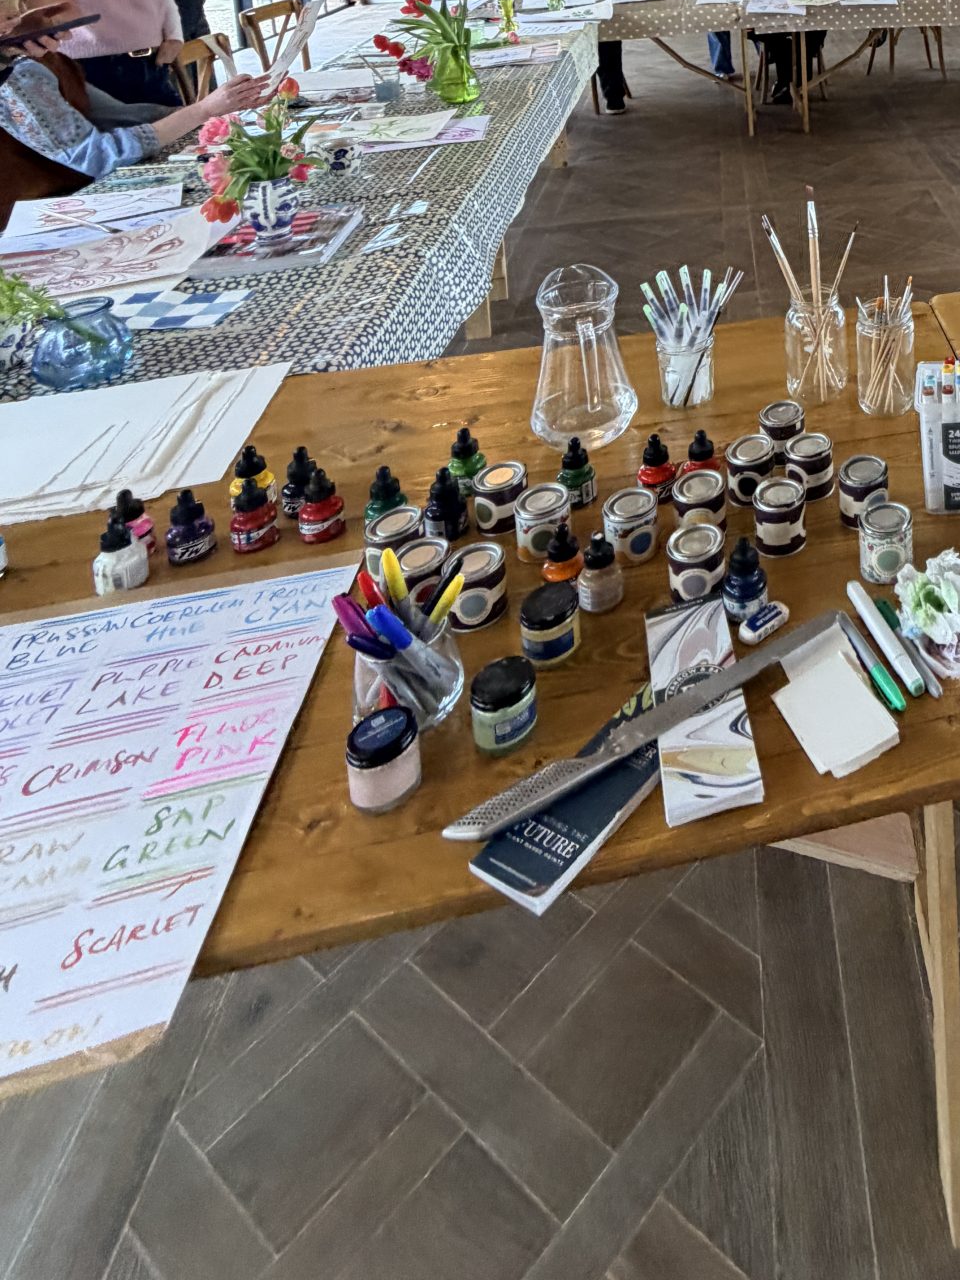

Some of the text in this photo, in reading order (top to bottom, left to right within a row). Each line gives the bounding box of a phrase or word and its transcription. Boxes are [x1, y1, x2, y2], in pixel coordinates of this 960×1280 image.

[948, 429, 960, 438] 24
[244, 595, 328, 624] CYAN
[5, 639, 99, 671] BLUE
[75, 680, 183, 716] LAKE
[174, 728, 277, 770] PINK
[21, 747, 159, 797] CRIMSON
[145, 793, 226, 836] SAP
[102, 818, 236, 871] GREEN
[60, 902, 206, 971] SCARLET
